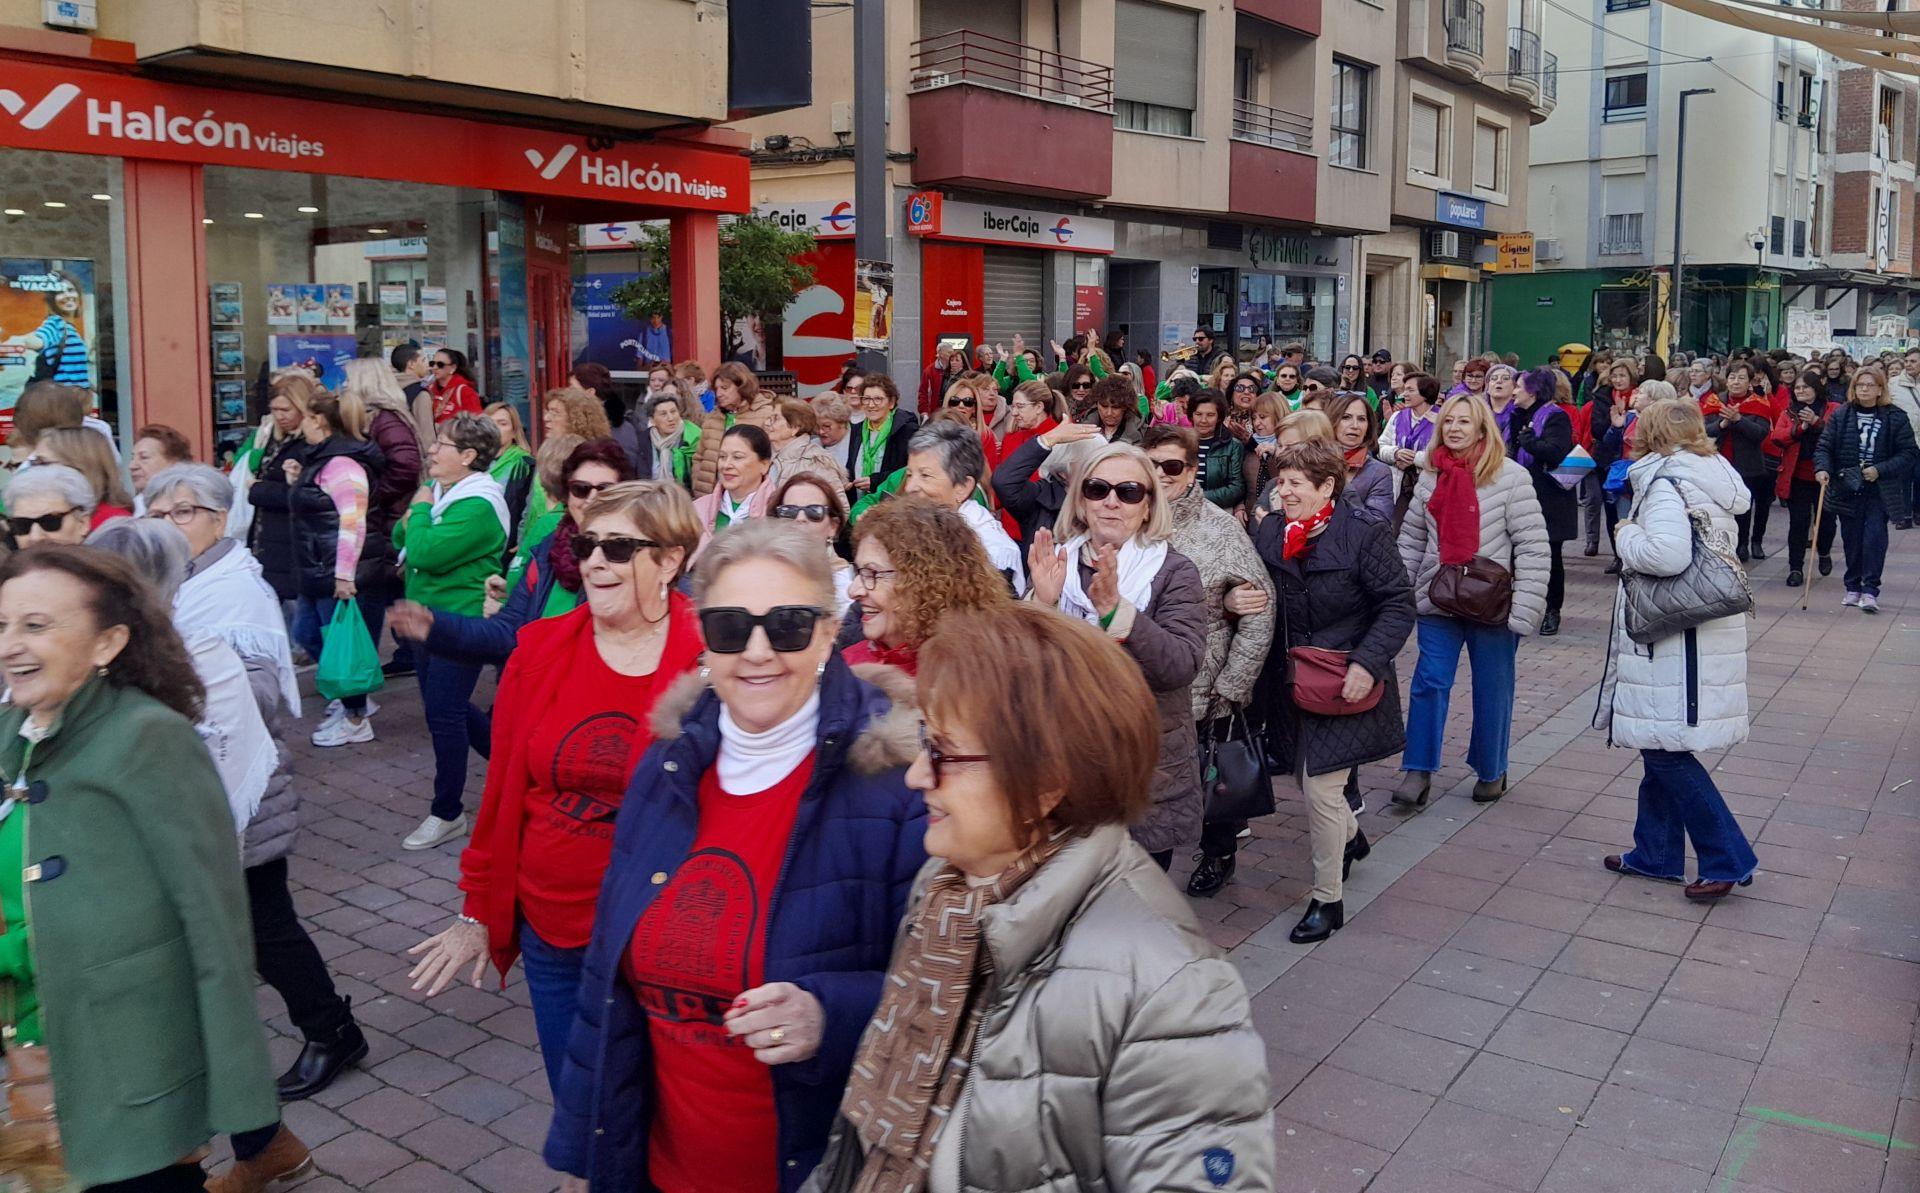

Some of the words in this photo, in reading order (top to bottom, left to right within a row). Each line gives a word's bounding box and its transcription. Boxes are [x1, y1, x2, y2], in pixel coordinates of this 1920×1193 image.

[86, 97, 250, 150] Halcón
[254, 132, 325, 158] viajes
[581, 155, 682, 195] Halcón
[682, 179, 728, 200] viajes
[983, 211, 1040, 238] iberCaja
[1499, 241, 1530, 255] digital
[1512, 257, 1517, 268] 1
